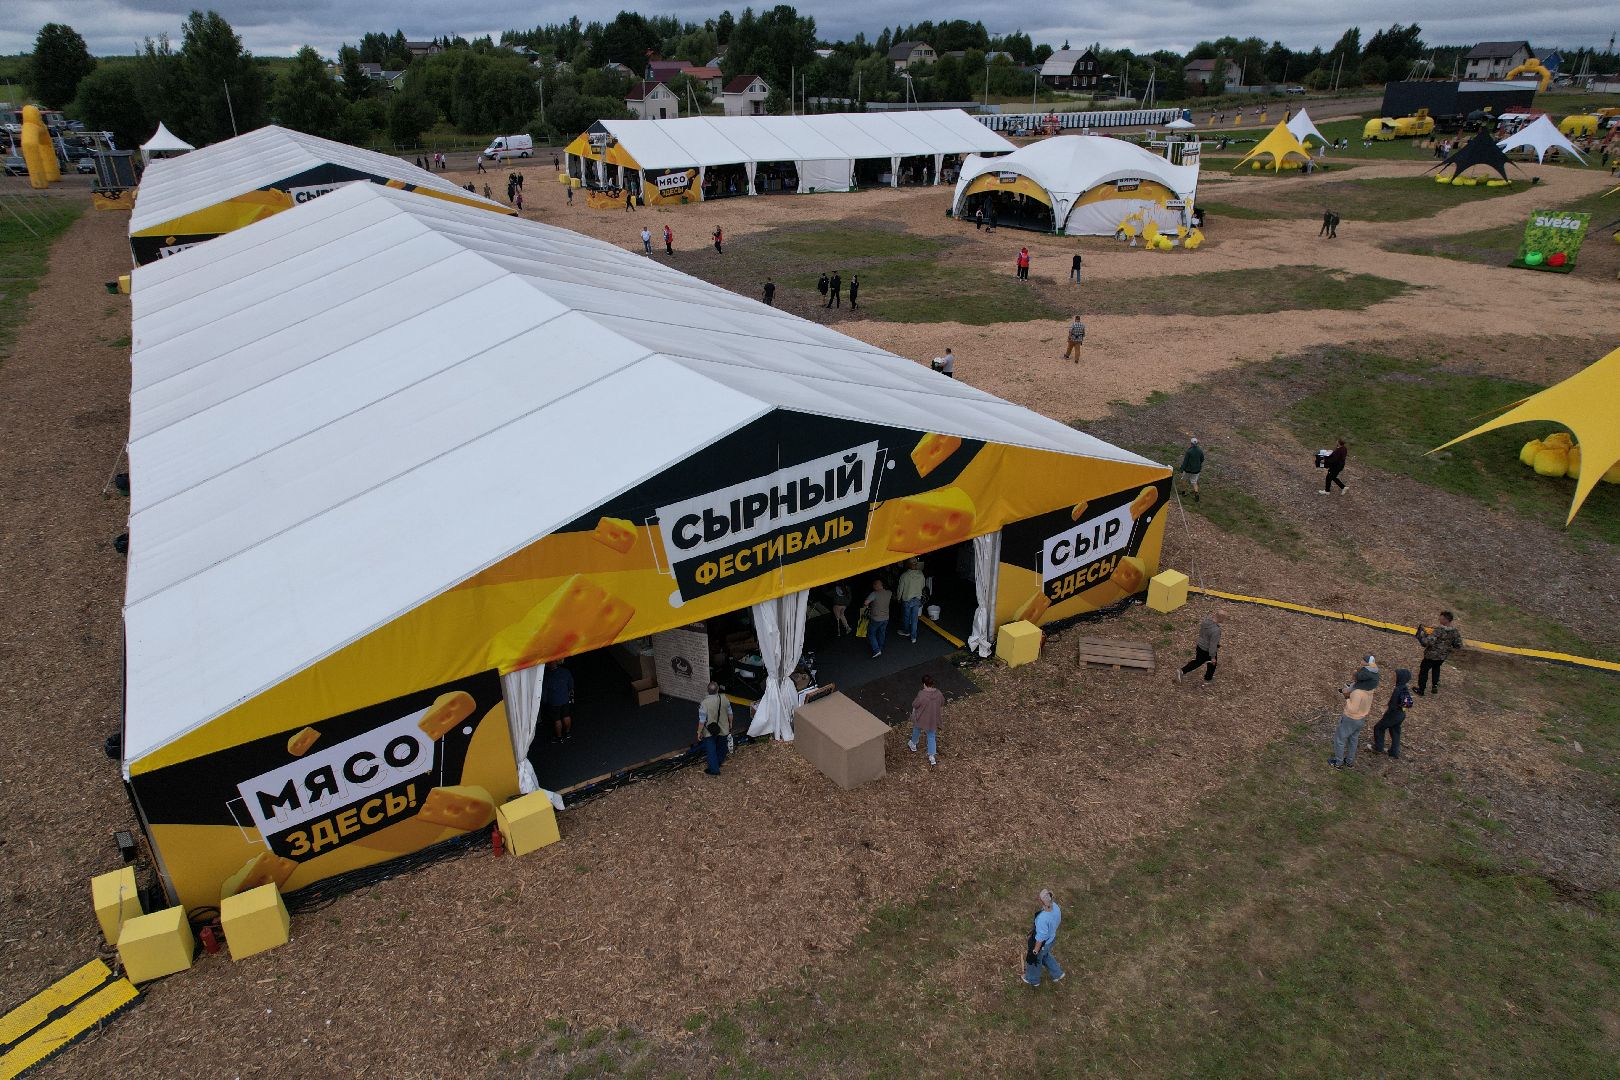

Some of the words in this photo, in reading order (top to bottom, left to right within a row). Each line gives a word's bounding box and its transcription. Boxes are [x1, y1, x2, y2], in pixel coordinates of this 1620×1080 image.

[659, 175, 686, 187] МЯСО
[671, 452, 866, 551] СЫРНЫЙ
[694, 516, 855, 586] ФЕСТИВАЛЬ
[1050, 517, 1122, 567] СЫР
[1050, 554, 1118, 600] ЗДЕСЬ!
[255, 735, 423, 822] МЯСО
[285, 783, 417, 856] ЗДЕСЬ!
